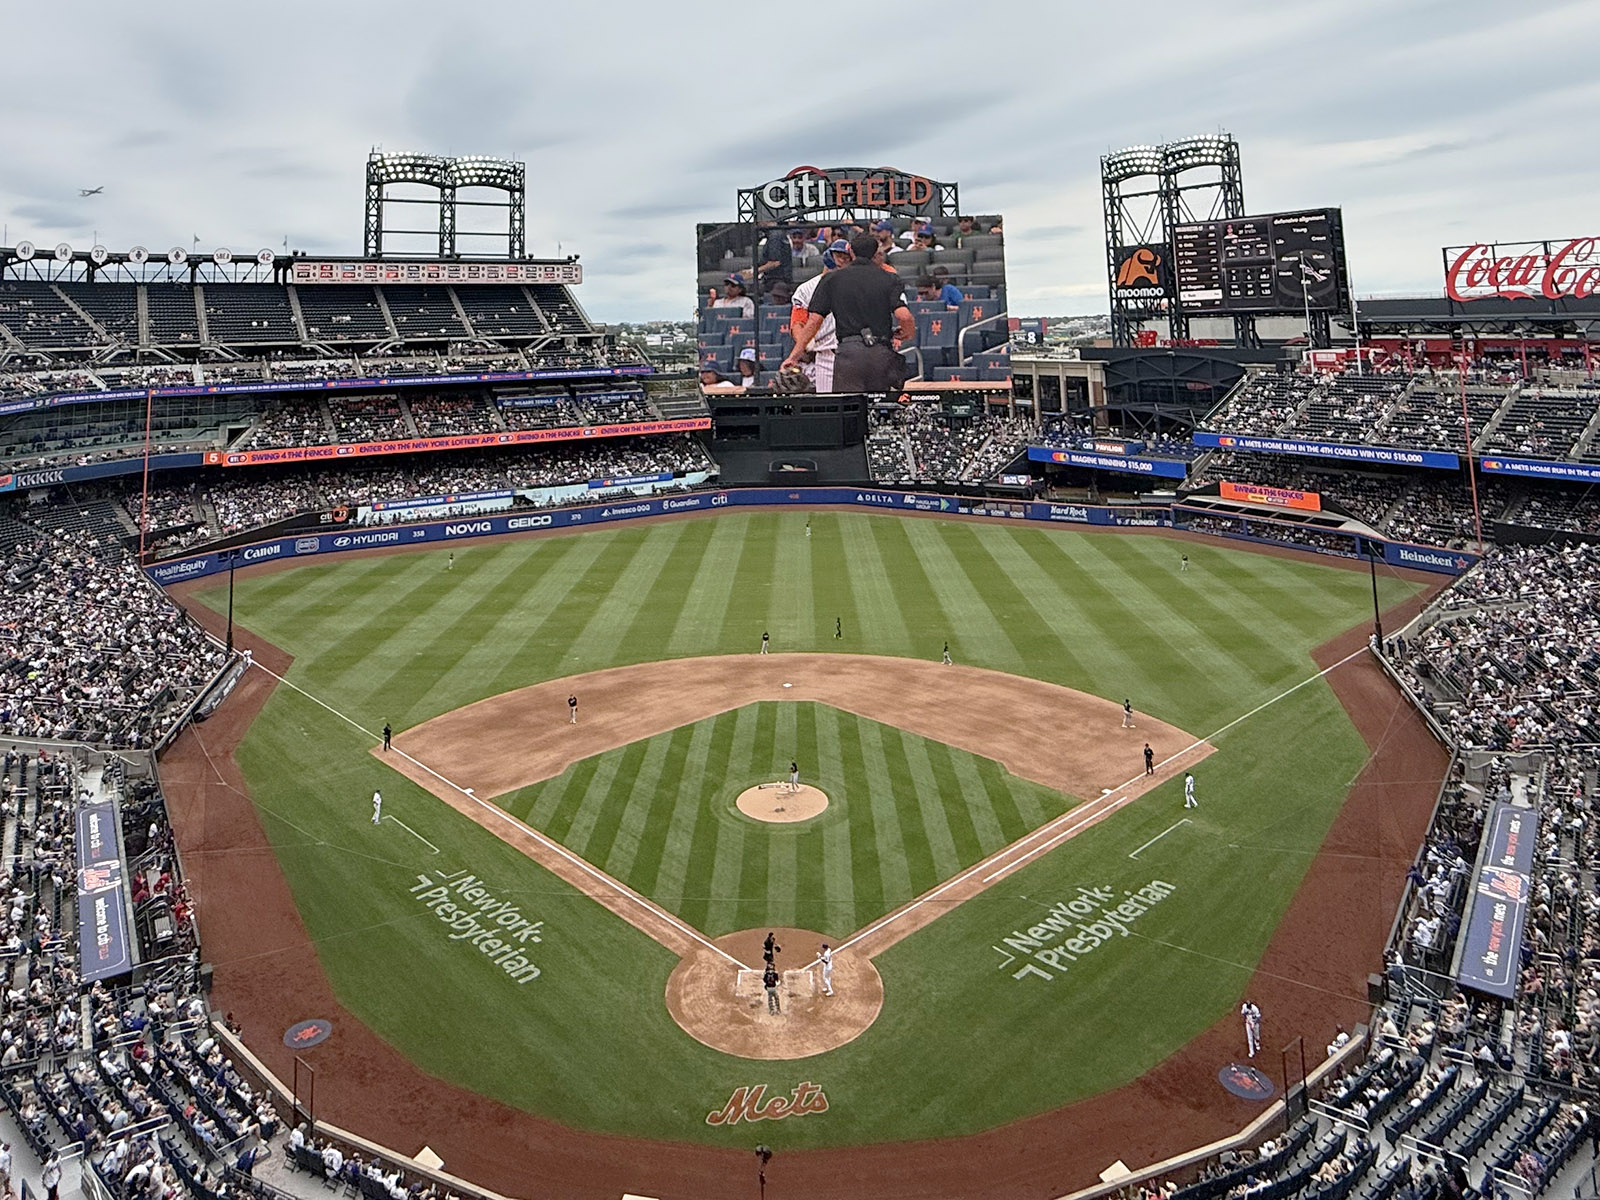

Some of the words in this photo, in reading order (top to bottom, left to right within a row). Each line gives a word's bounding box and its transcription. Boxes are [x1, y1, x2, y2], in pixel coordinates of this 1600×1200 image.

[762, 171, 826, 208] citi
[836, 176, 932, 206] FIELD
[20, 246, 30, 256] 41
[59, 248, 68, 258] 14
[94, 250, 104, 259] 37
[260, 253, 270, 262] 42
[1446, 237, 1600, 302] Coca-Co
[1117, 288, 1164, 298] moomoo
[1028, 332, 1036, 343] 8
[412, 440, 429, 448] NEW
[431, 439, 449, 447] YORK
[451, 437, 480, 446] LOTTERY
[1095, 444, 1123, 453] PAVILION
[210, 453, 217, 462] 5
[251, 453, 279, 462] SWING
[304, 449, 333, 457] FENCES
[1334, 448, 1358, 457] COULD
[1393, 453, 1422, 462] $15,000
[1071, 455, 1097, 464] IMAGINE
[1098, 458, 1127, 468] WINNING
[1128, 461, 1152, 471] $15,000
[17, 470, 63, 487] KKKKK
[712, 494, 727, 505] citi
[866, 495, 893, 503] DELTA
[1234, 485, 1257, 494] SWING
[1278, 491, 1304, 501] FENCES
[670, 499, 699, 508] Guardian
[612, 507, 636, 515] Invesco
[1050, 505, 1069, 514] Hard
[1070, 507, 1088, 517] Rock
[508, 516, 551, 528] GEICO
[446, 522, 491, 536] NOVIG
[353, 532, 399, 544] HYUNDAI
[244, 545, 280, 560] Canon
[1316, 547, 1358, 559] CADILLAC
[1400, 549, 1452, 567] Heineken
[155, 560, 207, 578] HealthEquity
[95, 897, 109, 925] welcome
[1493, 903, 1507, 921] mets
[97, 924, 109, 933] to
[1034, 880, 1176, 971] Presbyterian
[1488, 920, 1506, 937] york
[416, 886, 541, 984] Presbyterian
[1488, 936, 1500, 952] new
[1481, 951, 1499, 966] the
[706, 1081, 829, 1125] Mets
